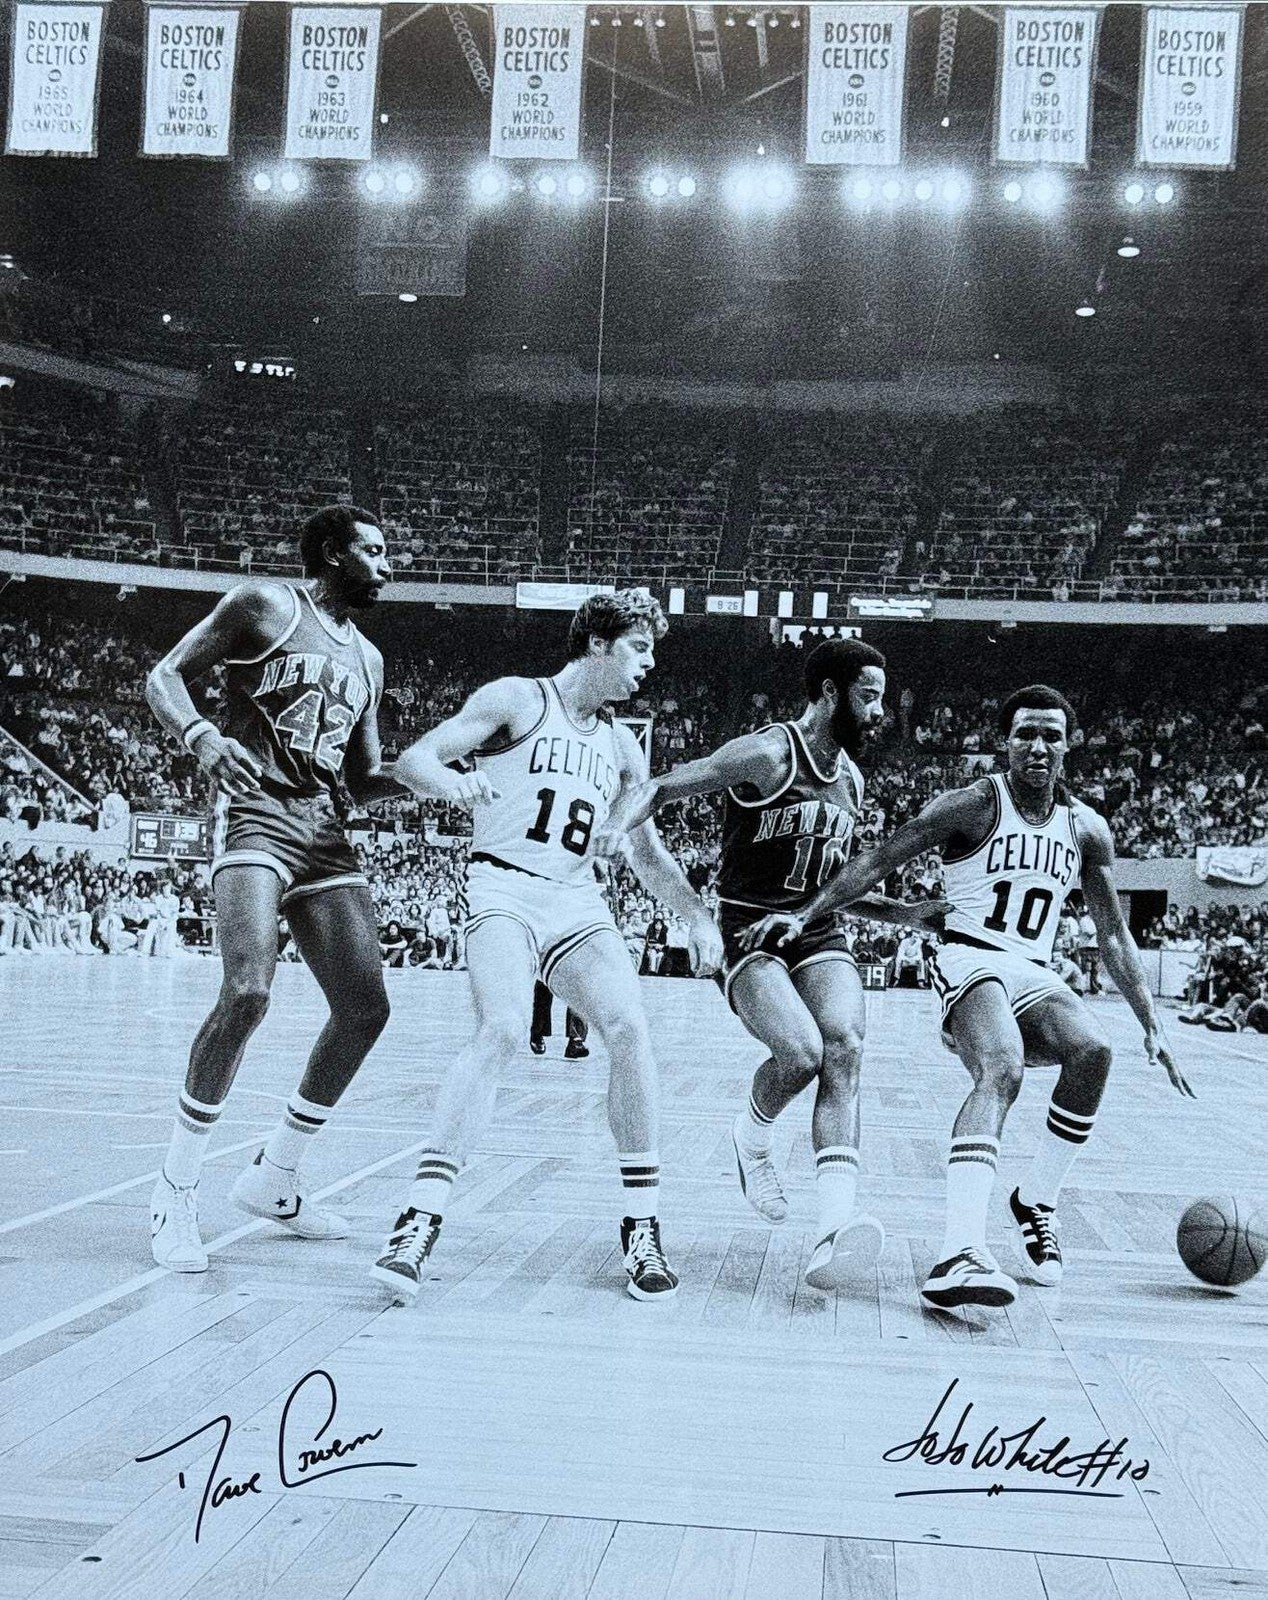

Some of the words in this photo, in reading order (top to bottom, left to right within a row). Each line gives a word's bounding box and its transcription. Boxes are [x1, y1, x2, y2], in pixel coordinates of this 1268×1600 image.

[28, 20, 90, 42] BOSTON
[160, 25, 225, 47] BOSTON
[303, 25, 369, 48] BOSTON
[503, 26, 571, 49] BOSTON
[824, 22, 893, 45] BOSTON
[1016, 21, 1086, 43] BOSTON
[1158, 29, 1227, 52] BOSTON
[26, 44, 88, 66] CELTICS
[160, 48, 223, 71] CELTICS
[302, 49, 366, 72] CELTICS
[503, 51, 570, 72] CELTICS
[822, 48, 890, 70] CELTICS
[1015, 45, 1082, 68] CELTICS
[1157, 54, 1224, 78] CELTICS
[175, 89, 204, 104] 1964
[318, 92, 346, 107] 1963
[517, 93, 549, 108] 1962
[842, 92, 868, 107] 1961
[168, 105, 209, 121] WORLD
[309, 108, 350, 124] WORLD
[512, 109, 555, 125] WORLD
[832, 110, 876, 126] WORLD
[157, 122, 219, 139] CHAMPIONS
[298, 125, 361, 141] CHAMPIONS
[501, 126, 566, 141] CHAMPIONS
[821, 129, 887, 145] CHAMPIONS
[1165, 119, 1210, 134] WORLD
[251, 652, 328, 698] NEW
[275, 689, 356, 772] 42
[529, 737, 615, 801] CELTICS
[525, 787, 596, 857] 18
[753, 800, 820, 843] NEW
[986, 833, 1075, 886] CELTICS
[983, 880, 1054, 941] 10
